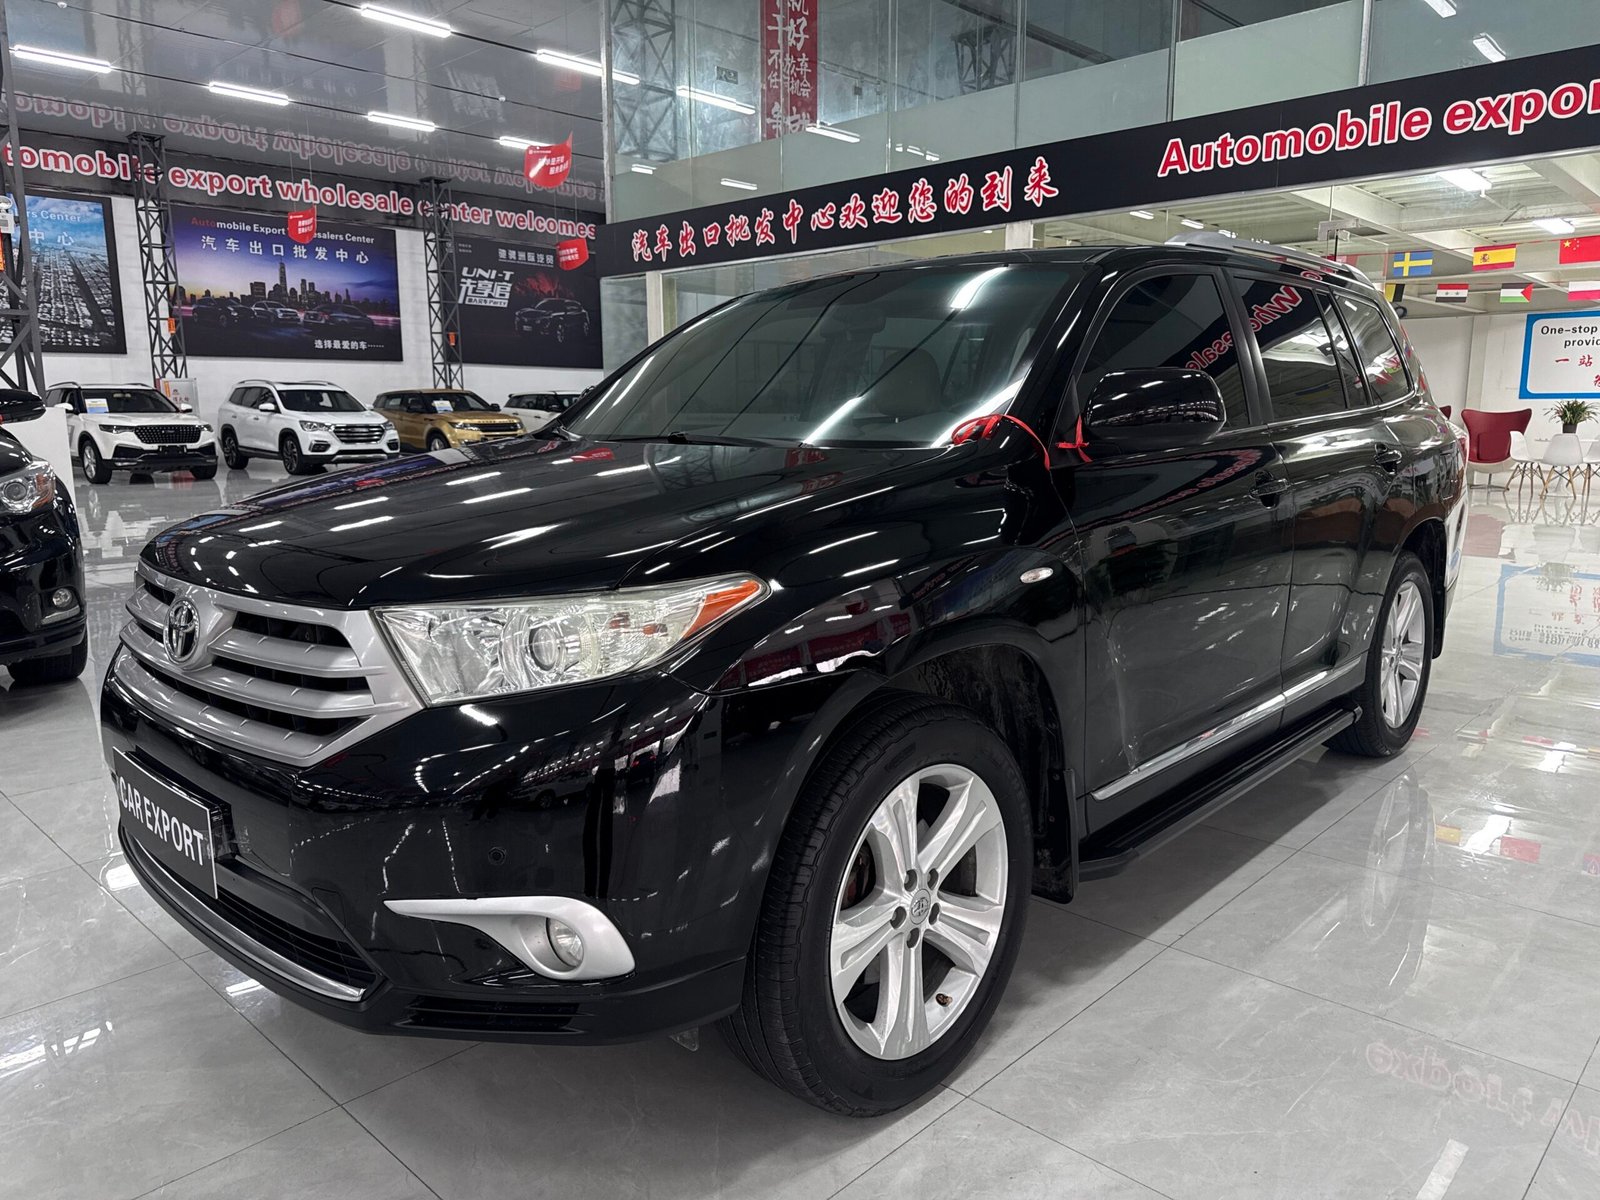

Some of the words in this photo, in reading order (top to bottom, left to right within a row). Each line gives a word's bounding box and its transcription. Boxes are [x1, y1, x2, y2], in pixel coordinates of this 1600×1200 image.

[1157, 100, 1431, 177] Automobile
[40, 210, 81, 222] Center
[168, 166, 273, 198] export
[277, 178, 414, 215] wholesale
[497, 209, 596, 240] welcomes
[631, 156, 1060, 262] 汽车出口批发中心欢迎您的到来
[191, 217, 251, 231] Automobile
[253, 224, 286, 236] Export
[345, 233, 375, 244] Center
[201, 235, 369, 264] 汽车出口批发中心
[462, 267, 514, 280] UNI-T
[1541, 325, 1598, 335] One-stop
[119, 776, 144, 824] CAR
[143, 795, 204, 866] EXPORT
